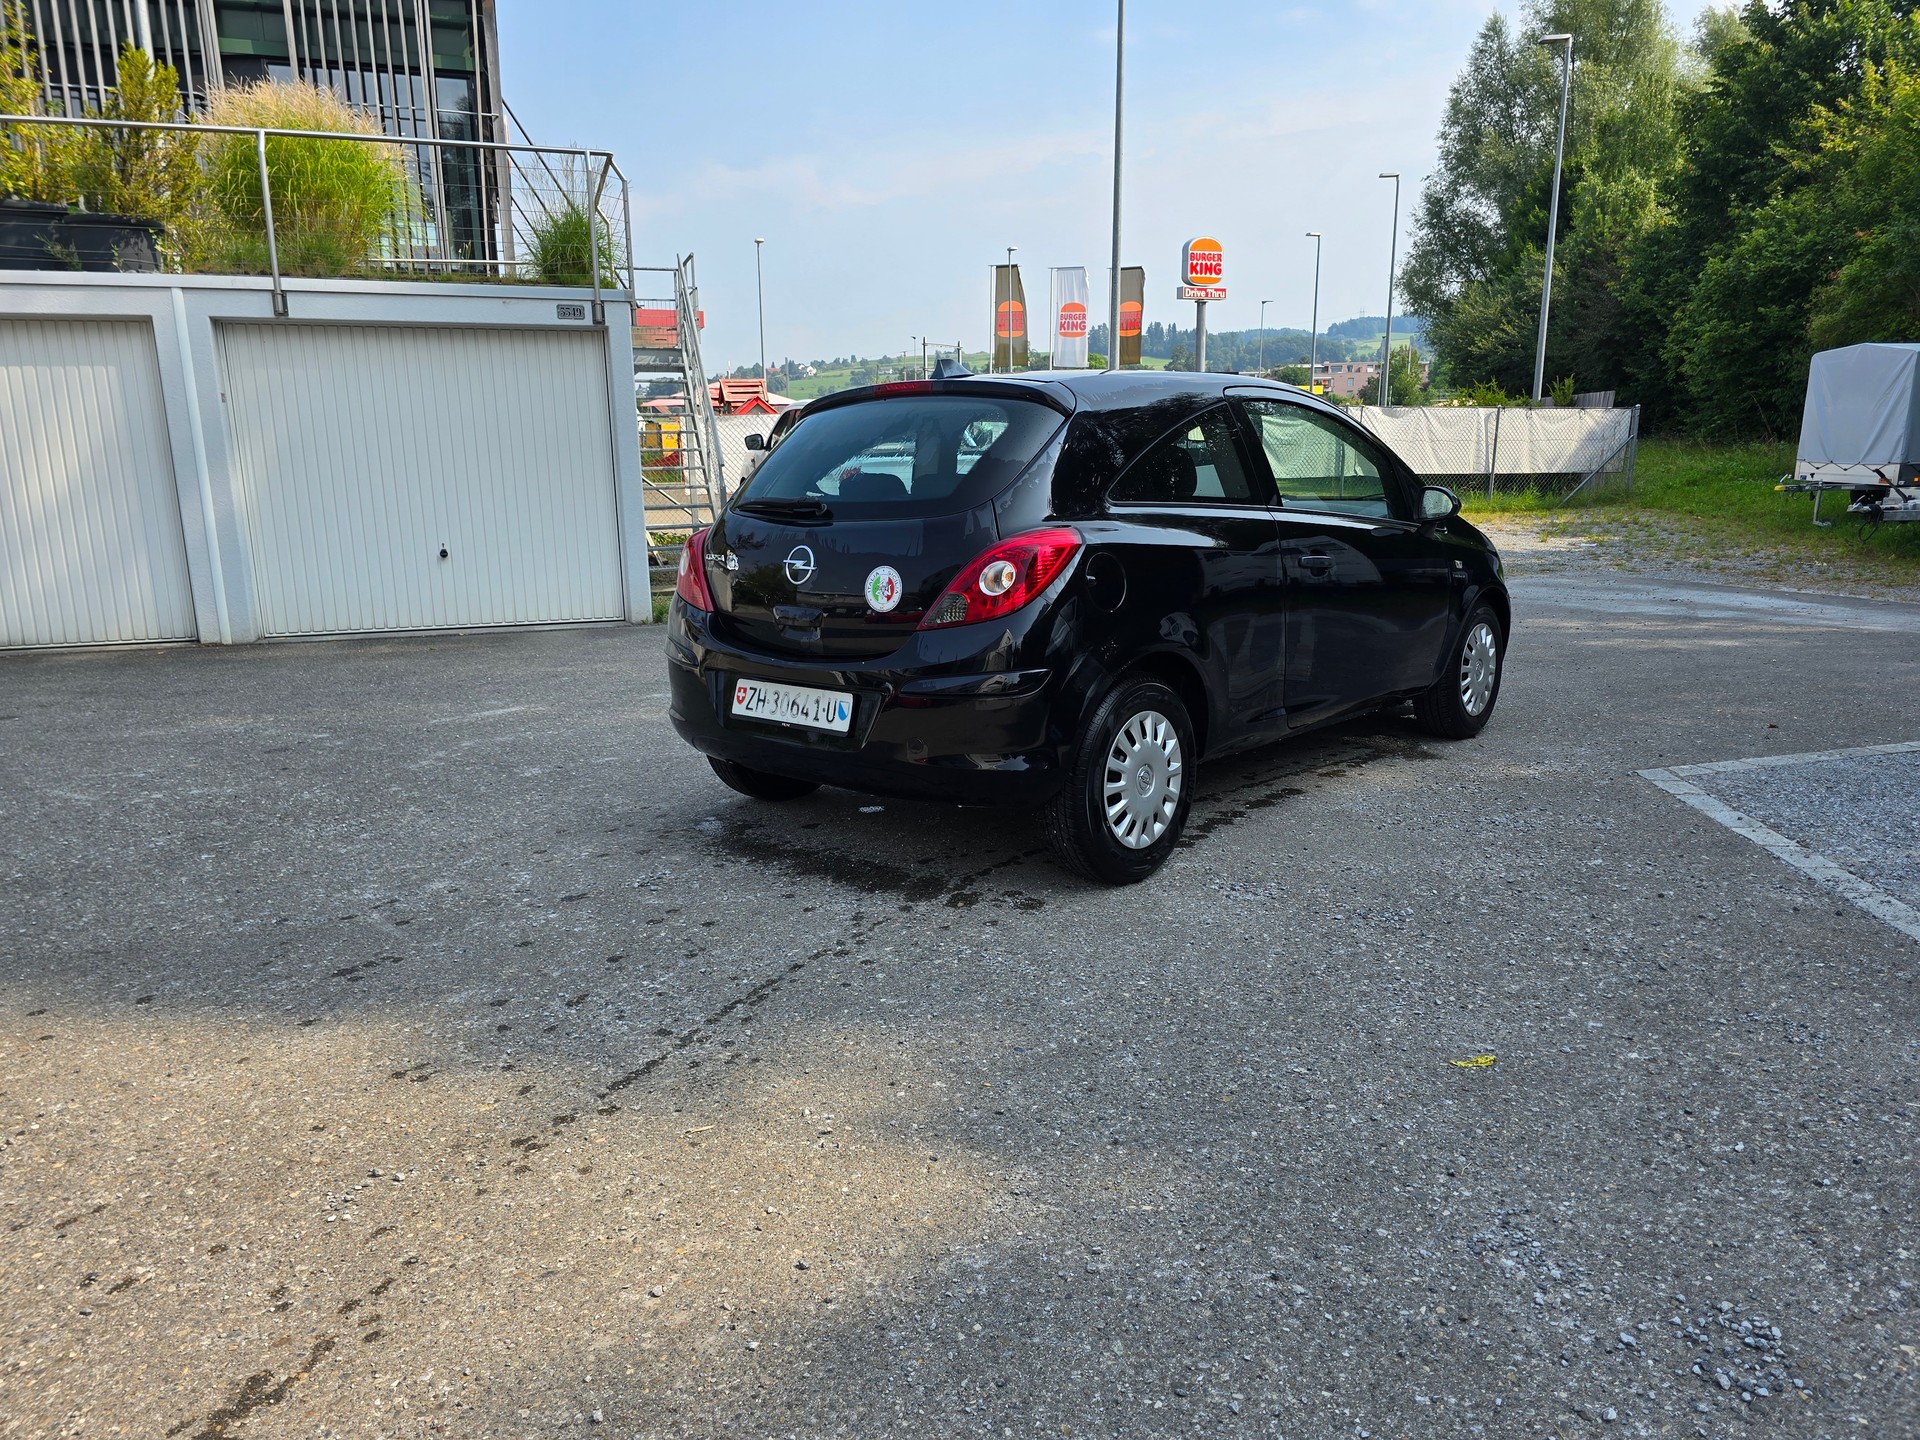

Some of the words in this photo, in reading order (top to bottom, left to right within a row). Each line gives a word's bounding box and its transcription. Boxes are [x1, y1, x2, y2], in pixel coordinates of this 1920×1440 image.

[1189, 252, 1222, 262] BURGER
[1189, 262, 1222, 276] KING
[1185, 287, 1206, 297] Drive
[1207, 288, 1226, 298] Thru
[1060, 313, 1087, 321] BURGER
[1059, 320, 1087, 332] KING
